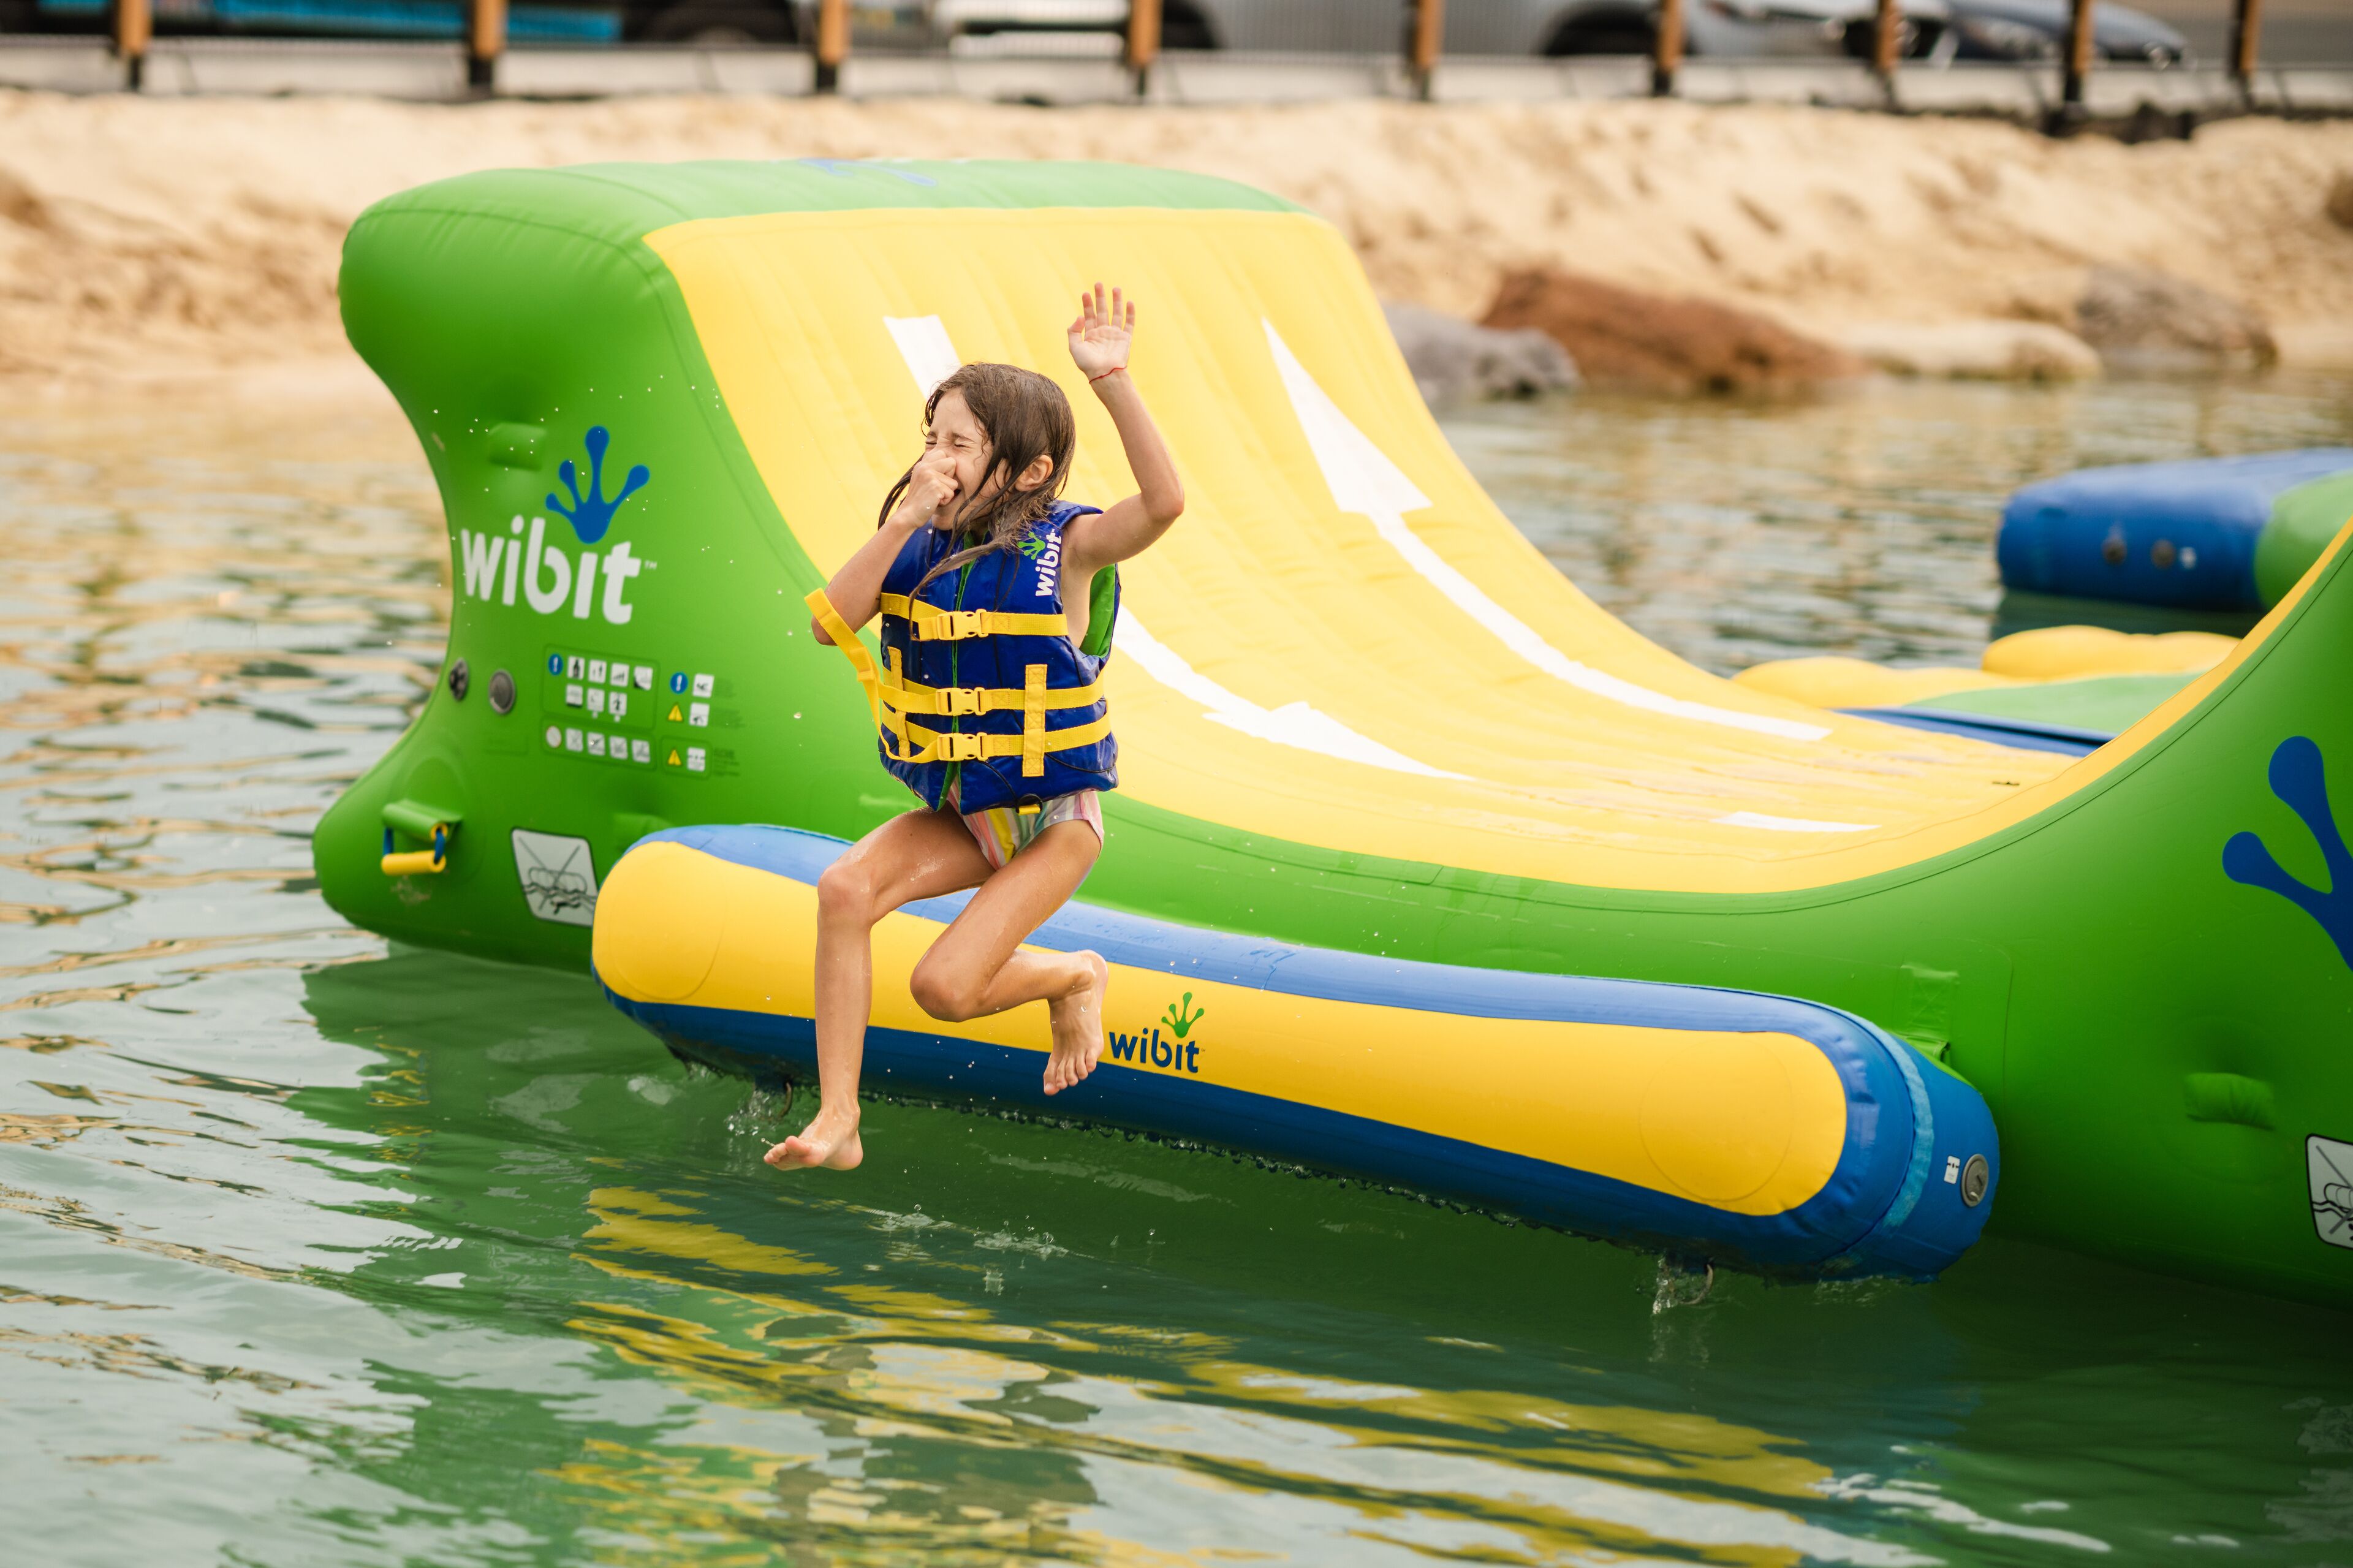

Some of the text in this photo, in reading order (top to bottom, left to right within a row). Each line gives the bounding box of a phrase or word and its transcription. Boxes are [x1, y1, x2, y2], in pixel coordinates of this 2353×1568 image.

[461, 514, 642, 625] wibit
[1035, 532, 1062, 596] wibit
[1108, 1028, 1200, 1074] wibit
